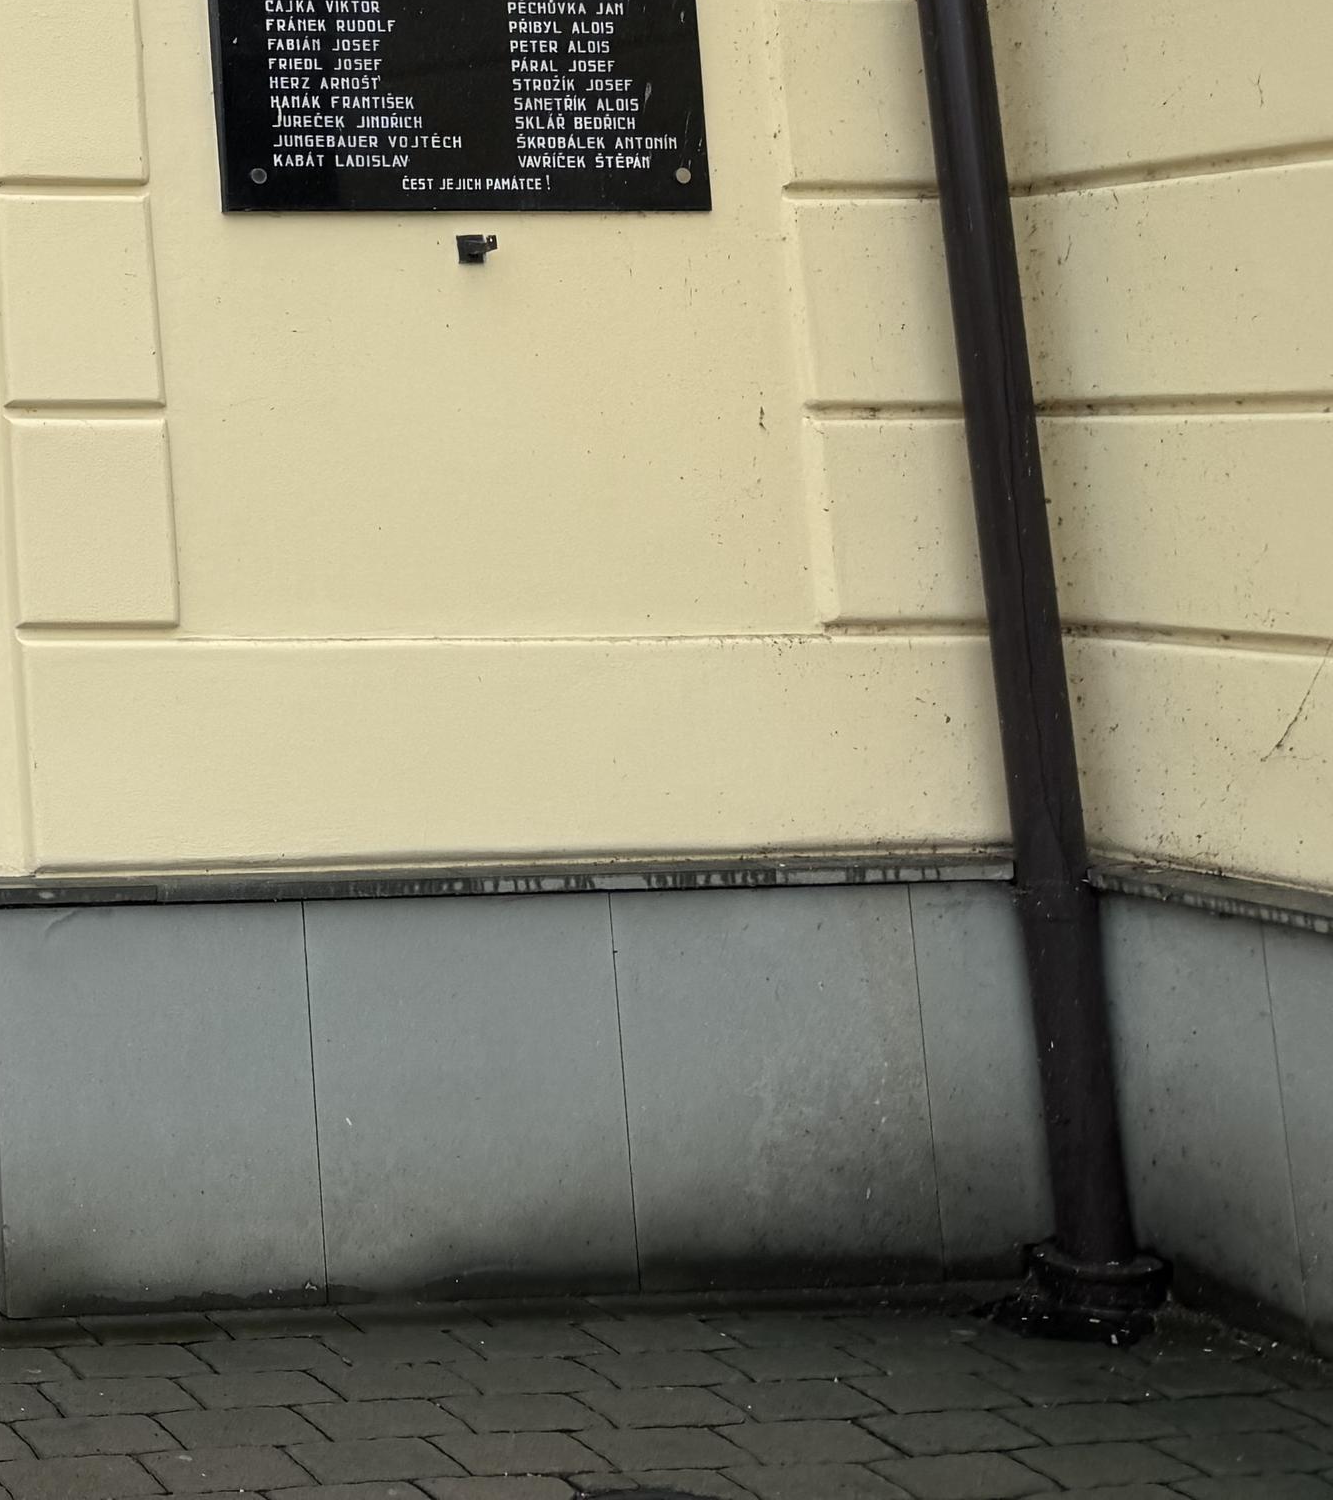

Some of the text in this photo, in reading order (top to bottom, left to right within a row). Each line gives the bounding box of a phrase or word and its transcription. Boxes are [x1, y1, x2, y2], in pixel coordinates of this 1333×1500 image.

[325, 0, 380, 13] VIKTOR
[595, 2, 624, 16] JAN
[265, 15, 396, 33] FRÁNEK RUDOLF
[508, 17, 614, 35] PŘIBYL ALOIS
[267, 35, 381, 52] FABIÁN JOSEF
[509, 39, 610, 54] PETER ALOIS
[268, 57, 382, 71] FRIEDL JOSEF
[511, 56, 615, 73] PÁRAL JOSEF
[269, 76, 310, 90] HERZ
[512, 74, 632, 92] STROŽÍK JOSEF
[270, 92, 414, 111] HANÁK FRANTIŠEK
[513, 94, 639, 112] SANETŘÍK ALOIS
[271, 110, 423, 129] JUREČEK JINDŘICH
[514, 113, 636, 130] SKLÁŘ BEDŘICH
[273, 132, 462, 149] JUNGEBAUER VOJTĚCH
[516, 133, 678, 150] ŠKROBÁLEK ANTONÍN
[273, 151, 409, 168] KABÁT LADISLAV
[517, 152, 652, 169] VAVŘÍČEK ŠTĚPÁN
[402, 175, 434, 191] ČEST
[440, 178, 482, 191] JEJICH
